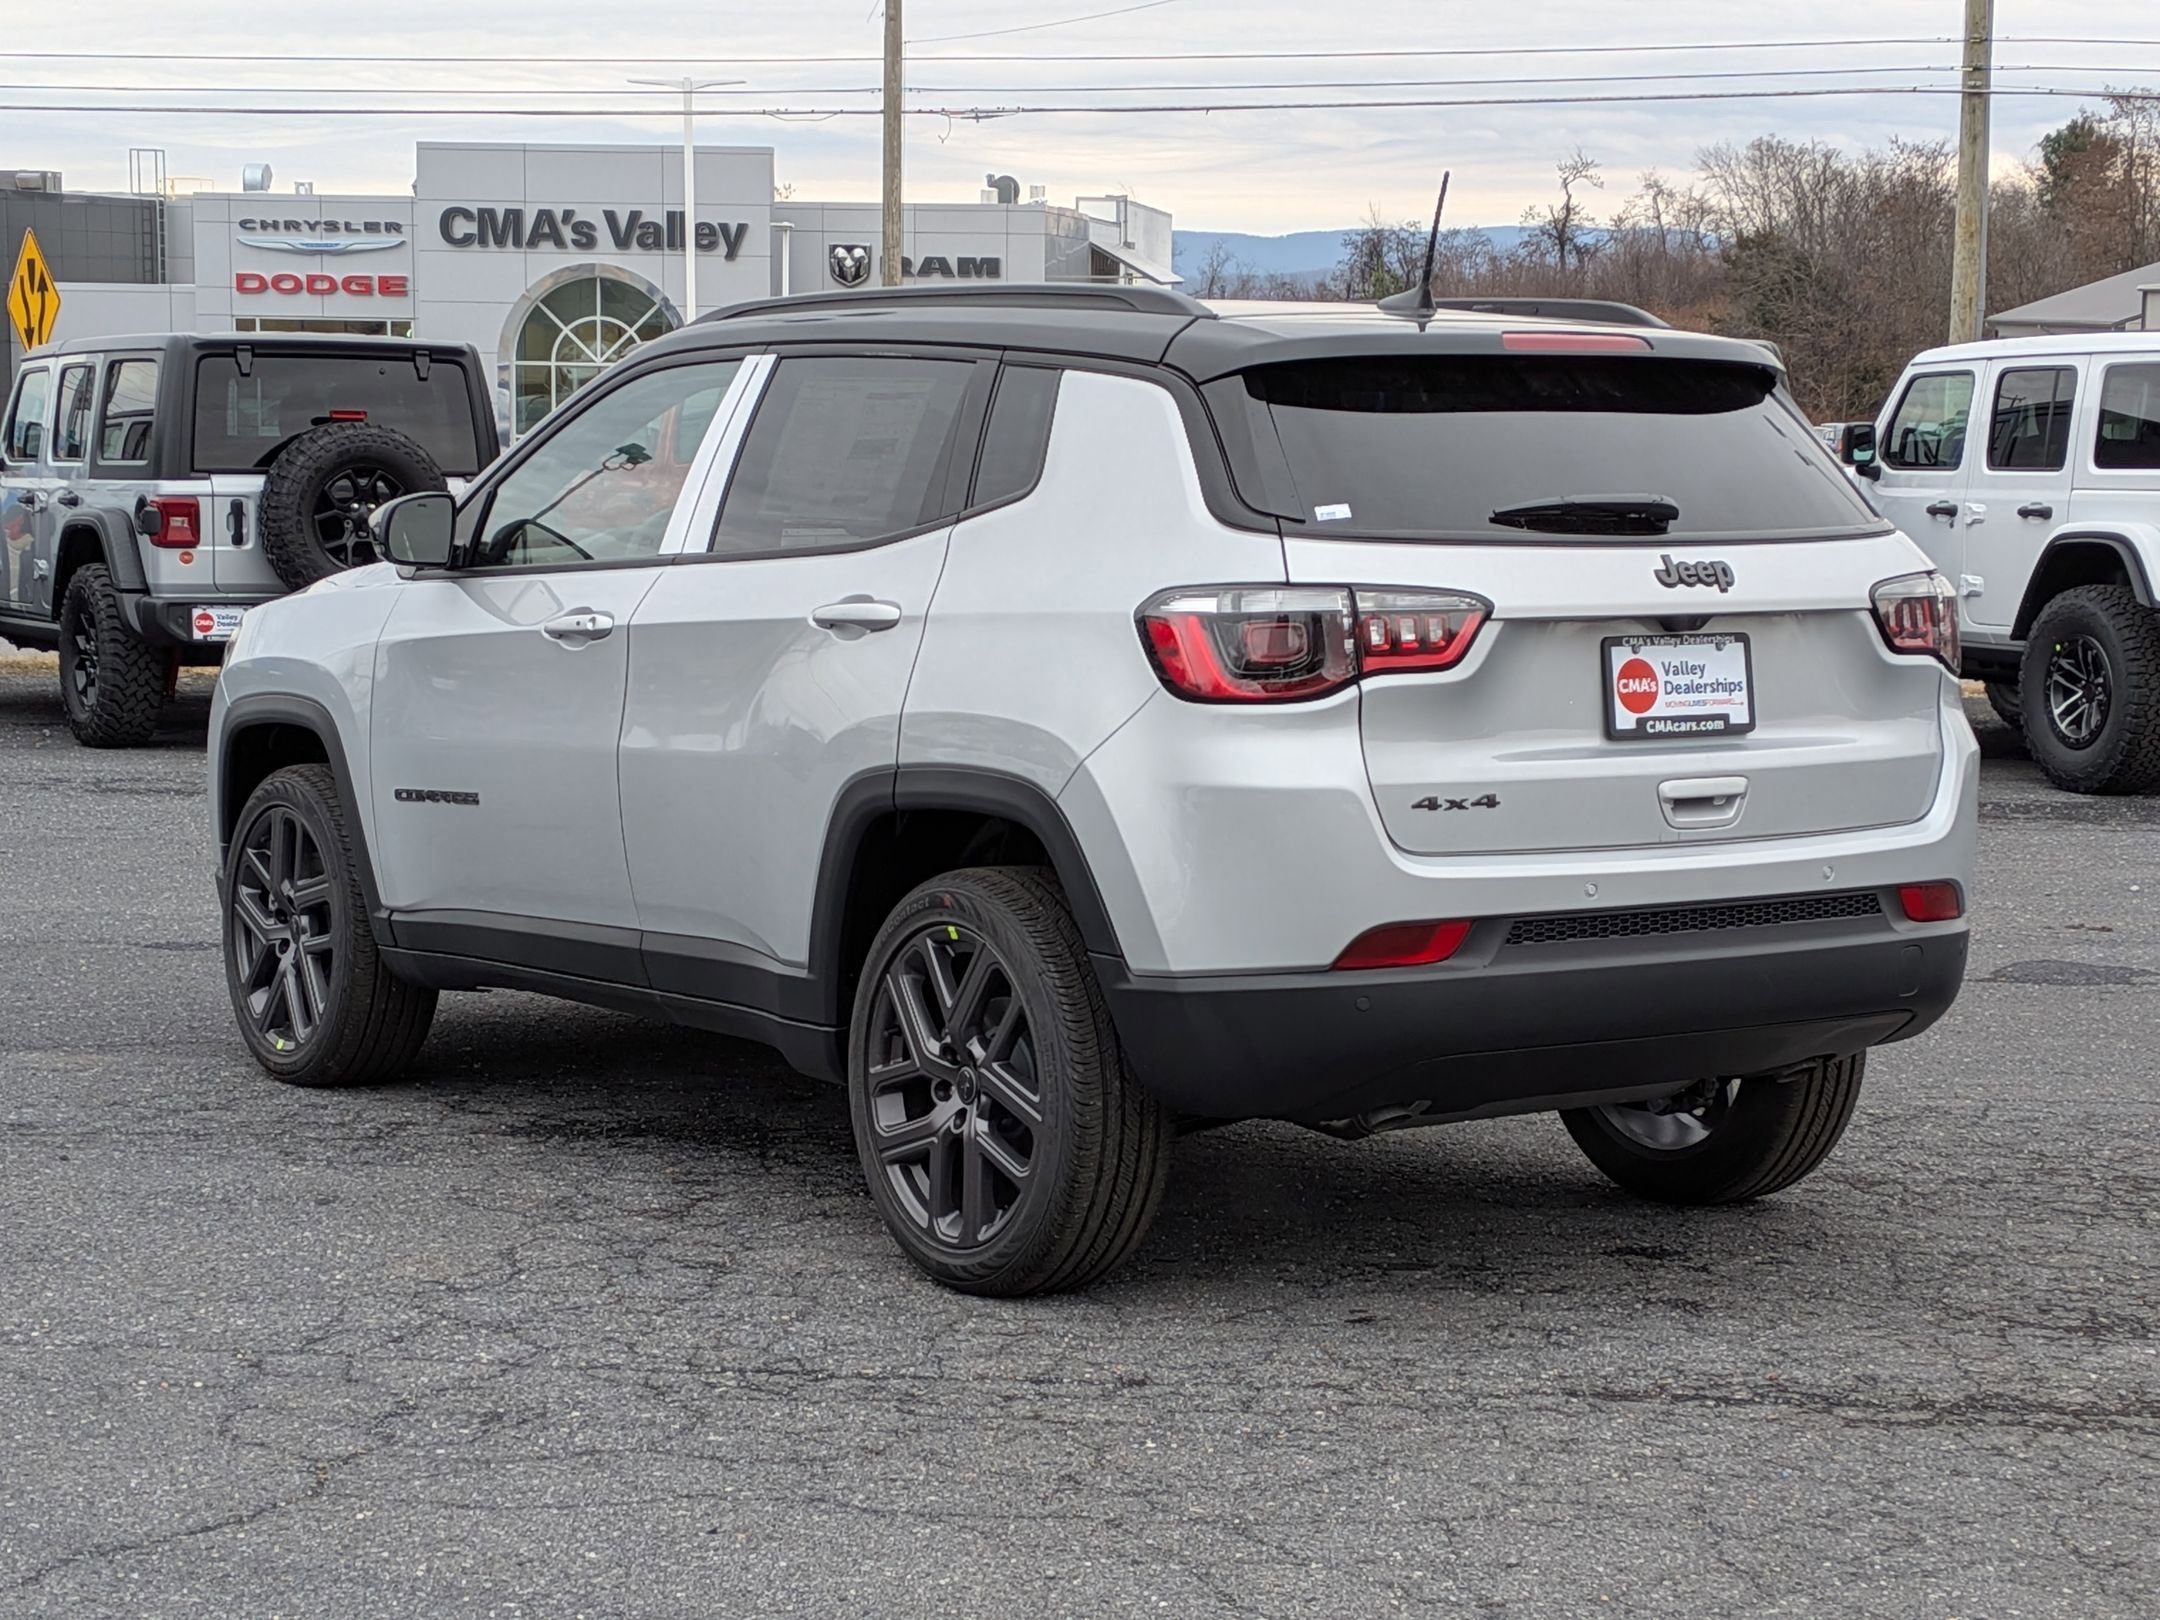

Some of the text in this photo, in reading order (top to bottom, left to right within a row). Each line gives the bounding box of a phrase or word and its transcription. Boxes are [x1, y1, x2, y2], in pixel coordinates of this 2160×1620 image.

[238, 218, 403, 234] CHRYSLER
[439, 207, 749, 262] CMA's Valley
[235, 272, 409, 297] DODGE
[1654, 554, 1736, 593] Jeep
[1661, 660, 1706, 679] Valley
[1618, 677, 1657, 694] CMA's
[1664, 678, 1743, 697] Dealerships
[1646, 718, 1725, 733] CMAcars.com
